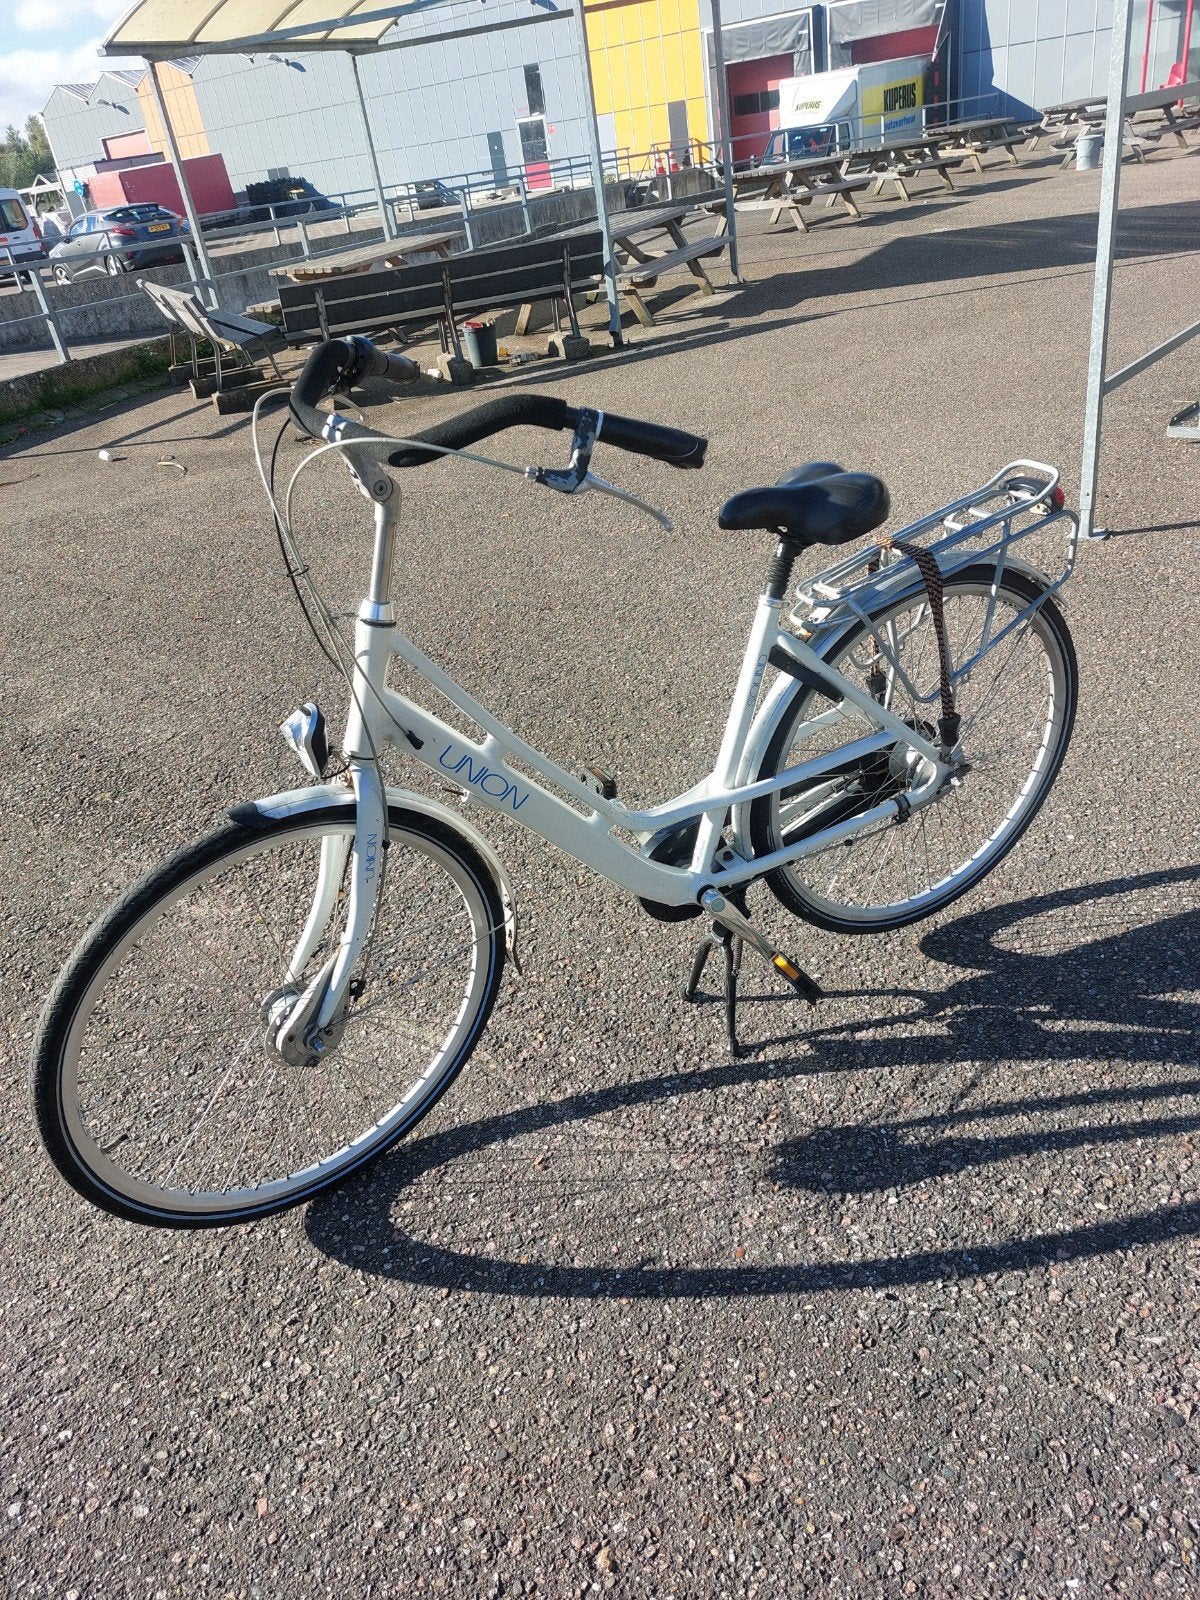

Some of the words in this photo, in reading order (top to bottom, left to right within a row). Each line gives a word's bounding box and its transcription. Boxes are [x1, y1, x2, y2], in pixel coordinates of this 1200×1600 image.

[883, 82, 916, 112] KUPERUS
[439, 745, 529, 809] UNION
[365, 833, 377, 884] UNION
